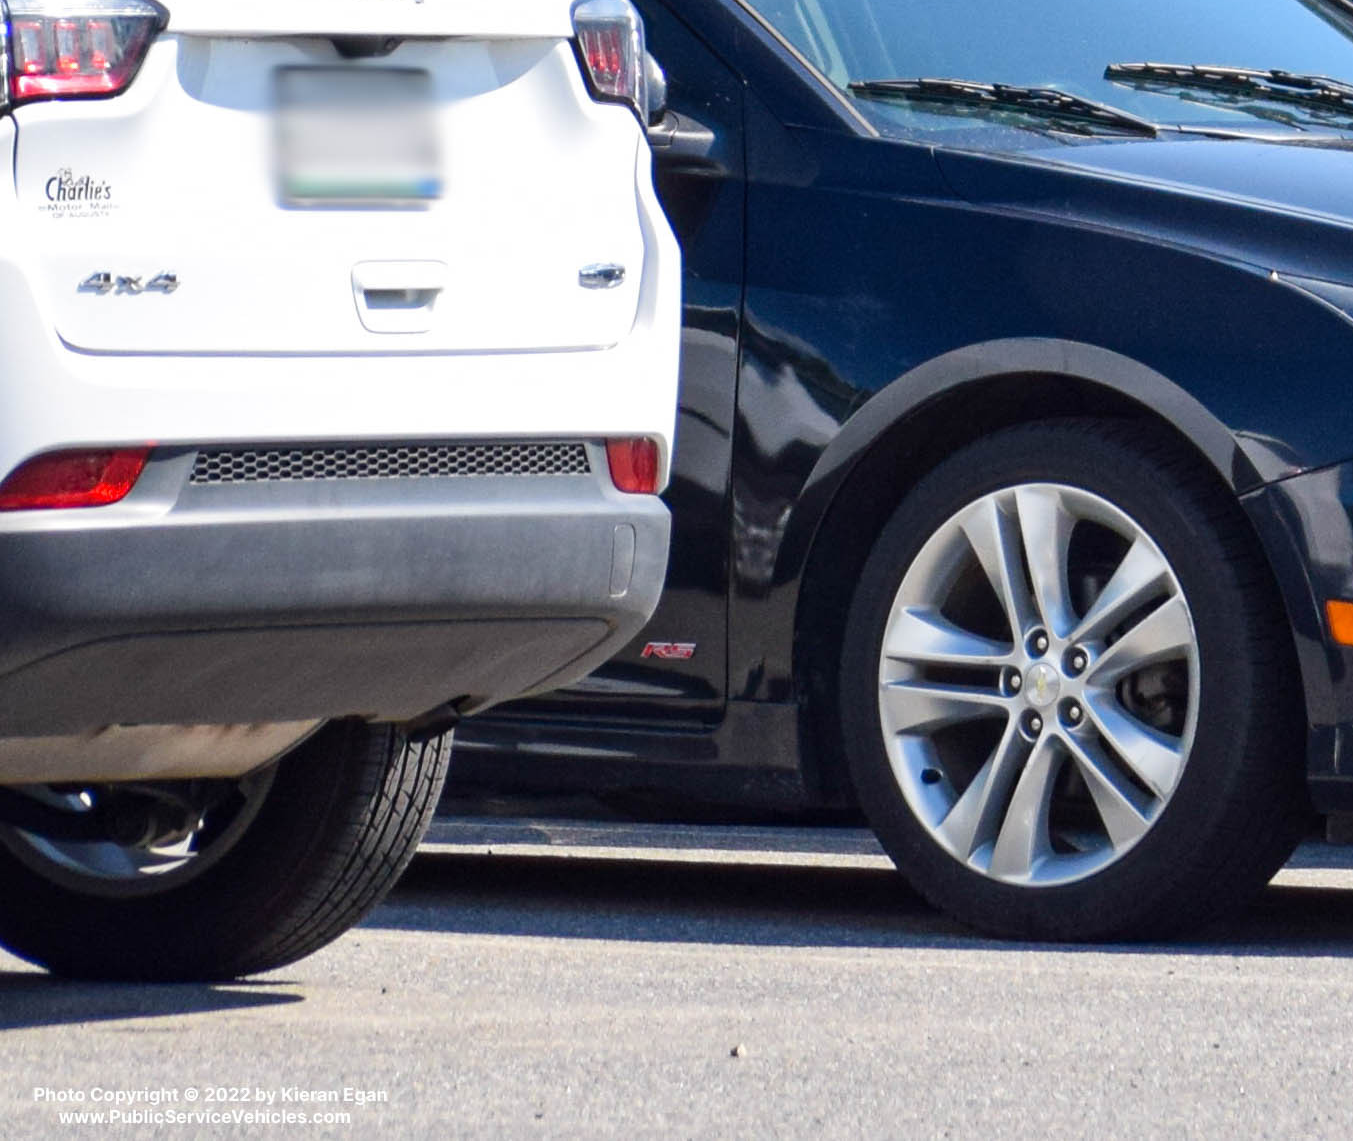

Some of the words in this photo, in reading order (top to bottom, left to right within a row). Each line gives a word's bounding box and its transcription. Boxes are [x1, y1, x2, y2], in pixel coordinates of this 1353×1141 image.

[45, 175, 112, 201] Charlie's
[77, 271, 180, 295] 4x4
[640, 642, 697, 659] RS
